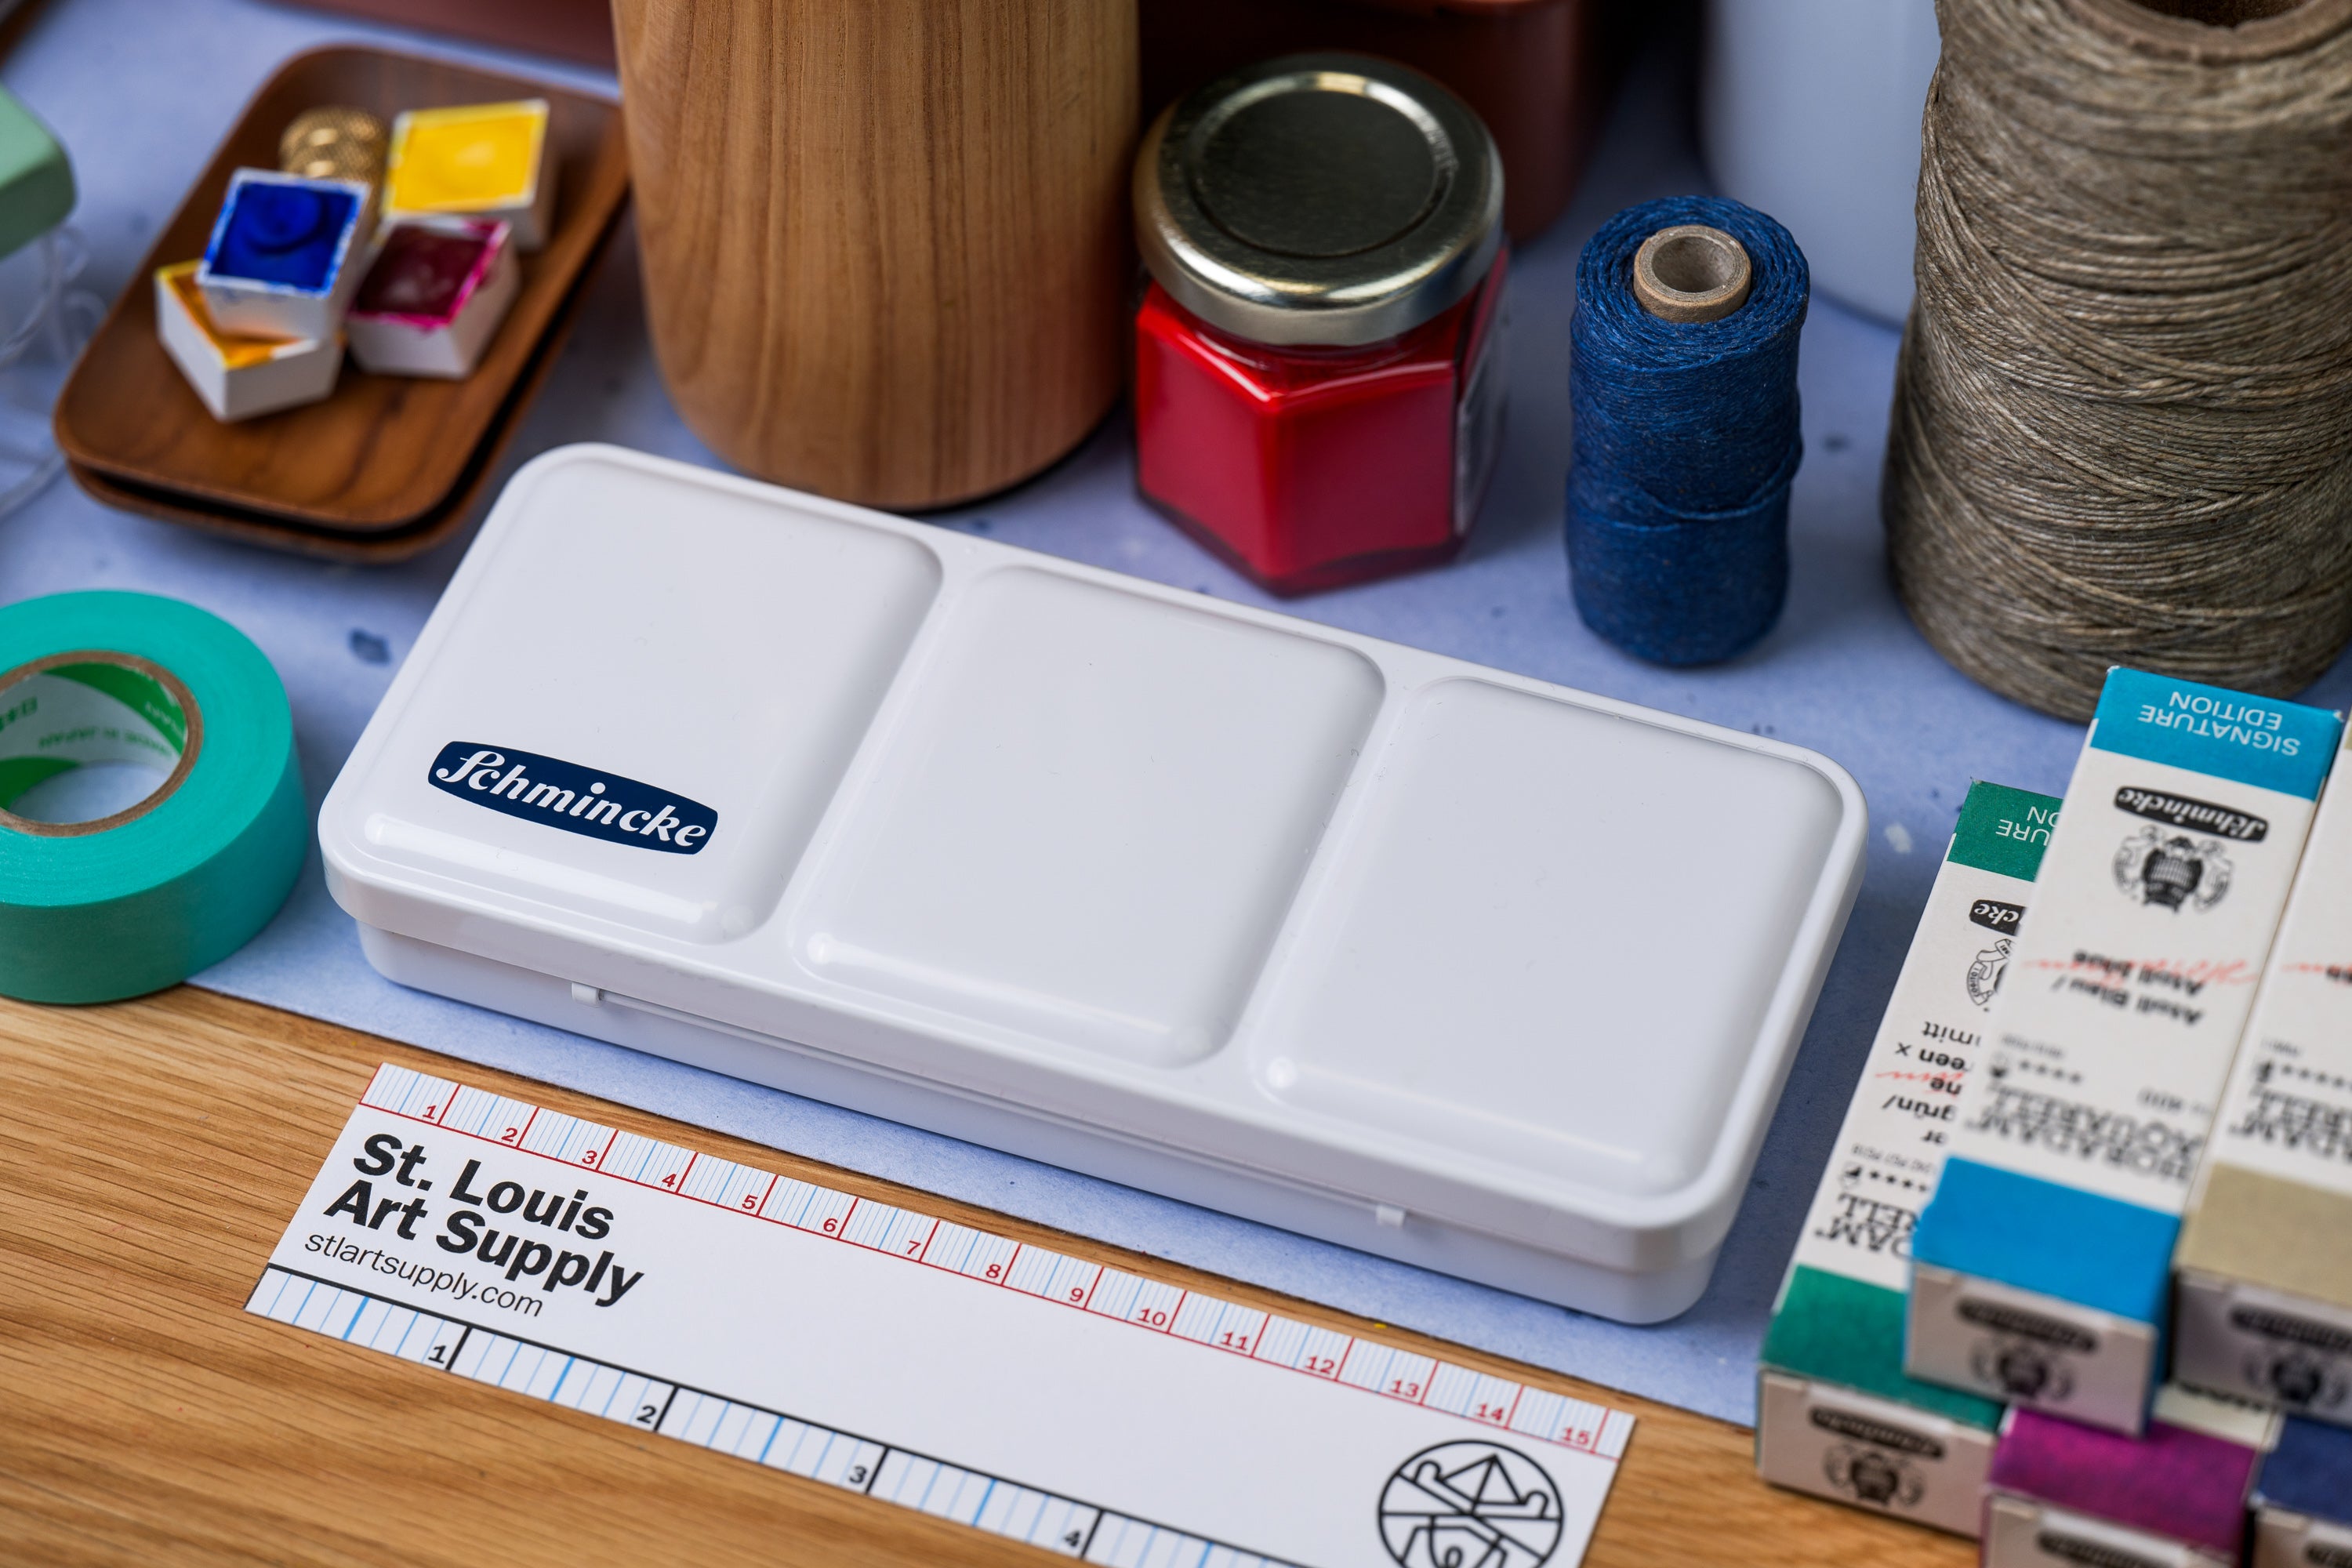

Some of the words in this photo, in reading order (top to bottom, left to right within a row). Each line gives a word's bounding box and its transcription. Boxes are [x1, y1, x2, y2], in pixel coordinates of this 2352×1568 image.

[2136, 704, 2301, 757] SIGNATURE
[2169, 691, 2283, 731] EDITION
[436, 750, 706, 847] Schmincke
[2118, 787, 2265, 839] Schmincke
[1995, 818, 2050, 847] URE
[1974, 902, 2020, 926] cke
[1922, 1021, 1976, 1045] mitt
[353, 1134, 434, 1191] St.
[449, 1160, 614, 1240] Louis
[304, 1234, 543, 1316] stlartsupply.com
[324, 1181, 428, 1240] Art
[435, 1210, 644, 1307] Supply
[422, 1105, 436, 1120] 1
[500, 1127, 518, 1143] 2
[582, 1150, 597, 1166] 3
[662, 1174, 677, 1189] 4
[741, 1194, 756, 1210] 5
[822, 1218, 838, 1233] 6
[906, 1240, 921, 1256] 7
[985, 1264, 1001, 1279] 8
[1069, 1287, 1084, 1303] 9
[1137, 1308, 1166, 1326] 10
[1220, 1331, 1248, 1350] 11
[1304, 1355, 1334, 1374] 12
[1388, 1379, 1419, 1398] 13
[1473, 1403, 1504, 1422] 14
[1560, 1426, 1590, 1446] 15
[428, 1345, 445, 1364] 1
[637, 1404, 656, 1423] 2
[849, 1465, 867, 1483] 3
[1063, 1530, 1082, 1548] 4
